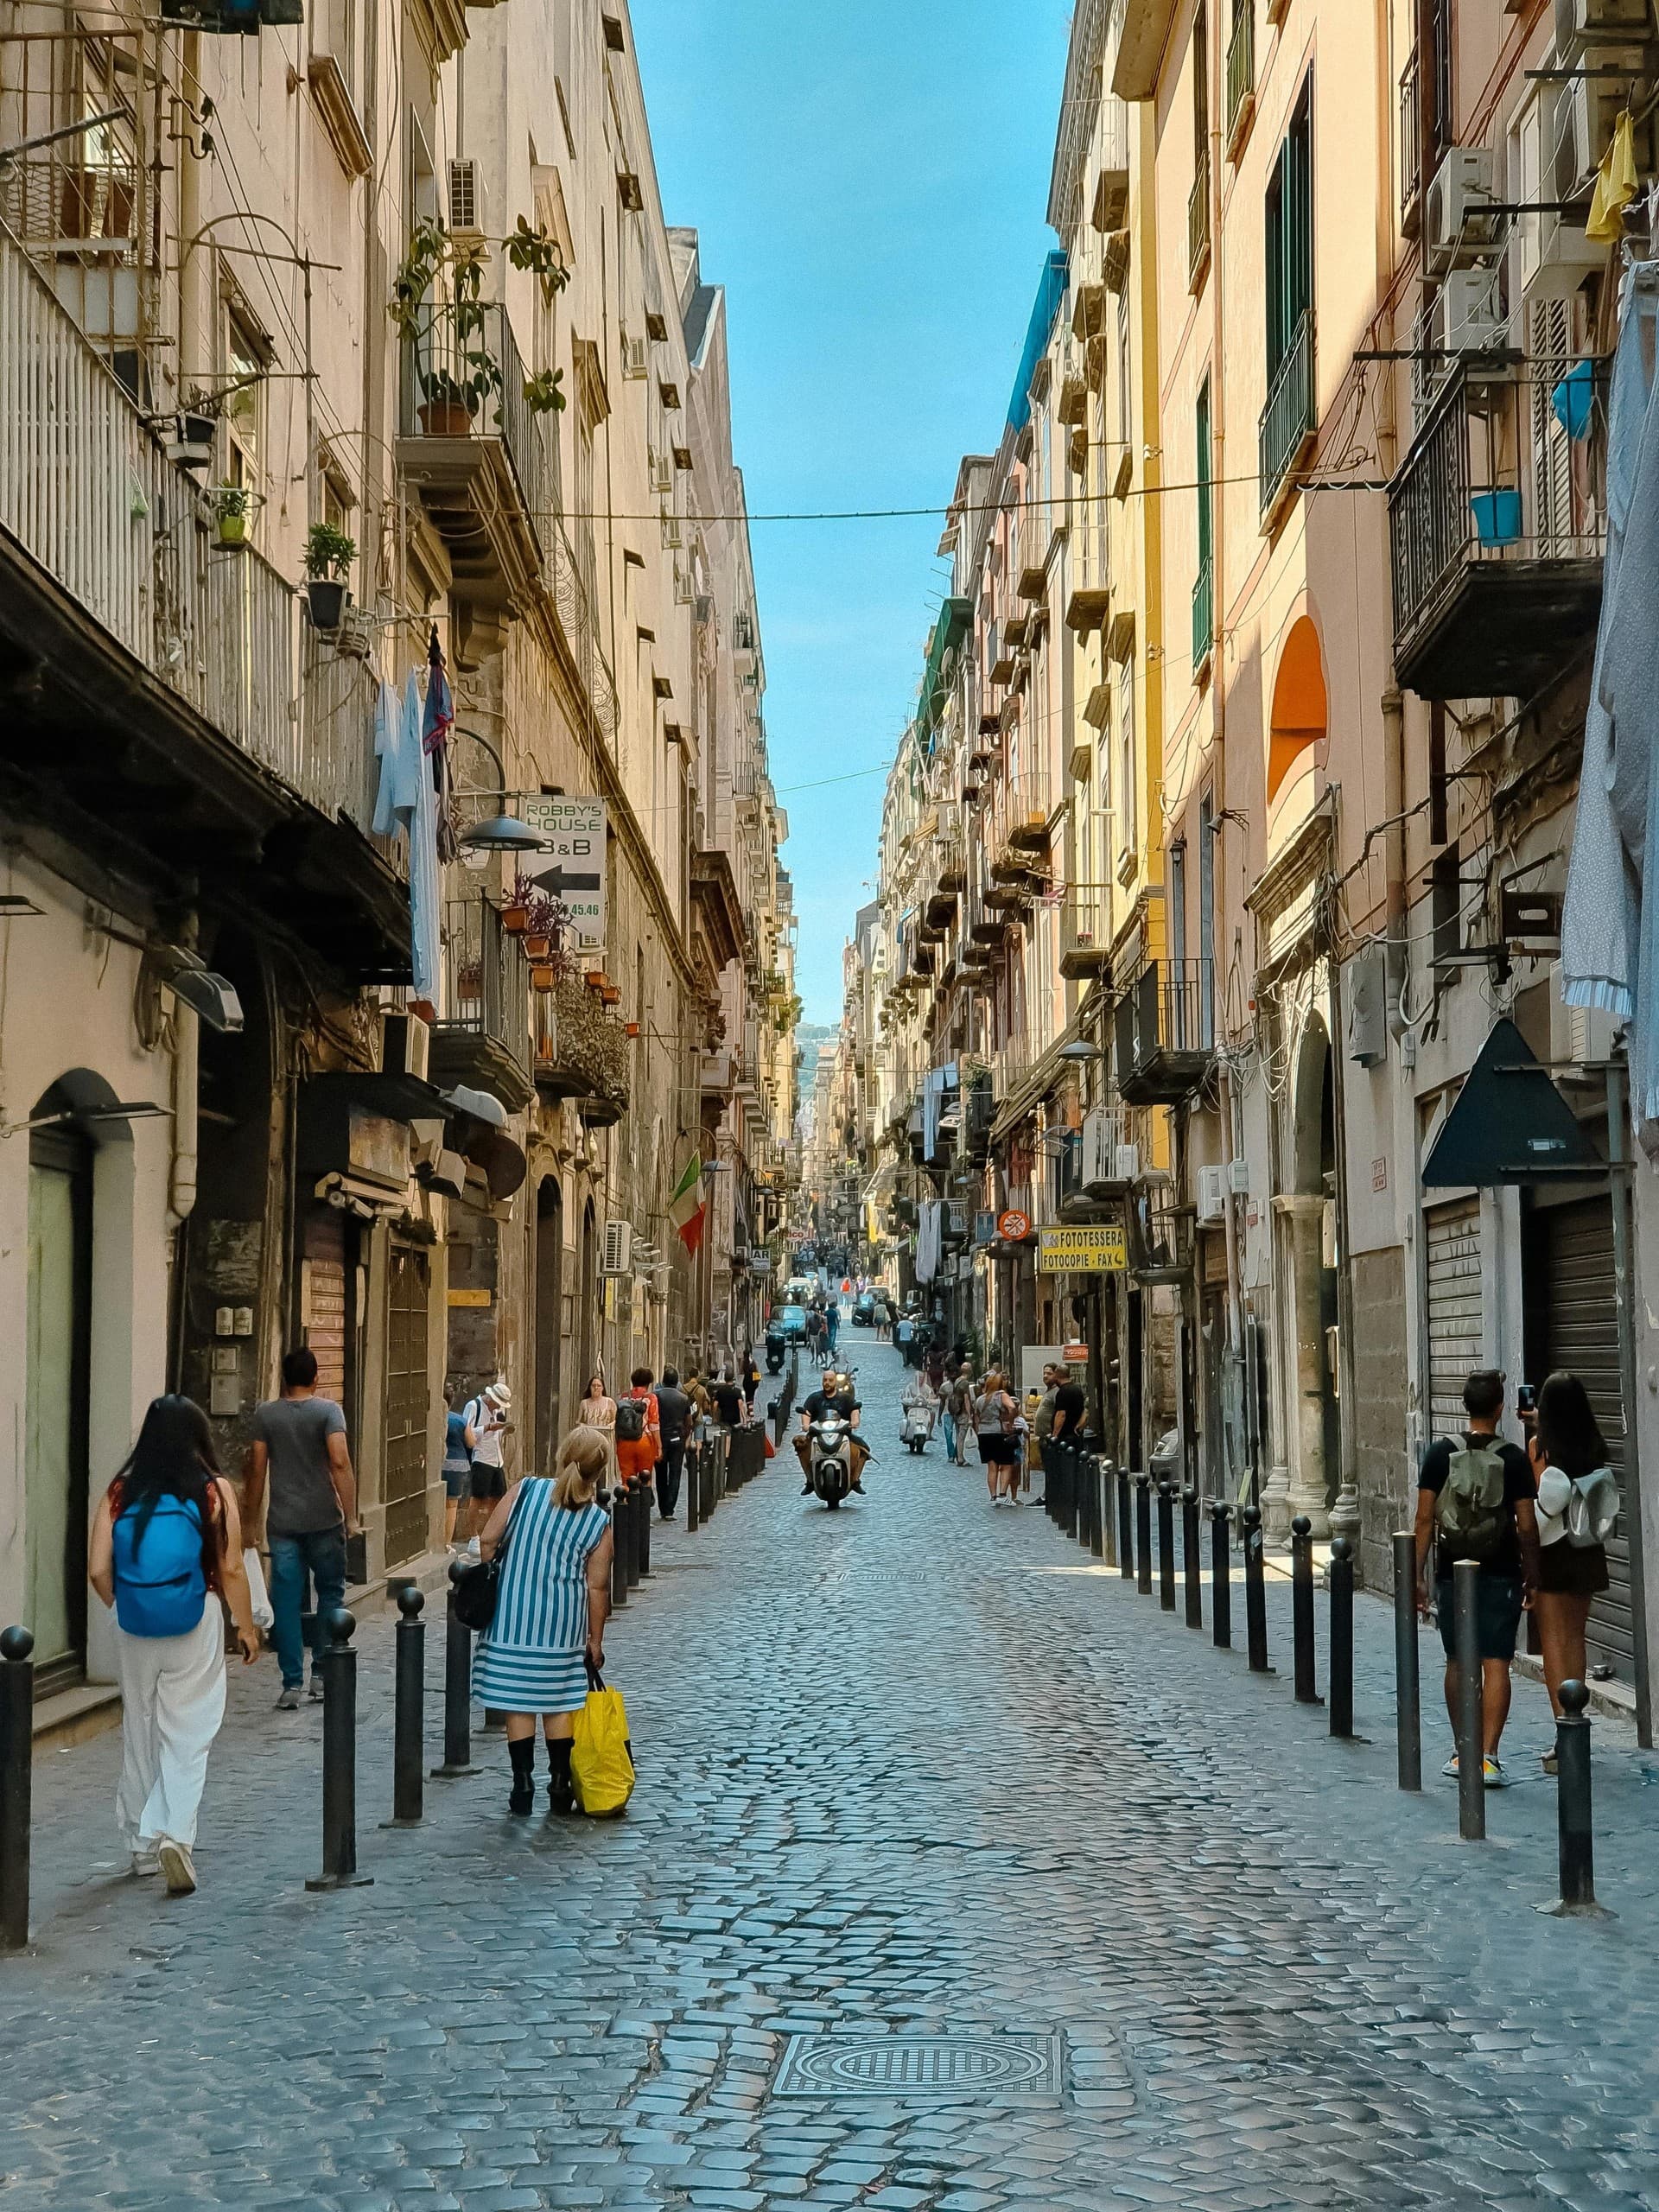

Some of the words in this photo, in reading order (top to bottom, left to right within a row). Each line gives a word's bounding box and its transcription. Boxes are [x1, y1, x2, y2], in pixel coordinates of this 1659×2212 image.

[526, 804, 601, 817] ROBBY'S
[527, 817, 601, 831] HOUSE
[536, 838, 591, 855] B&B
[1060, 1230, 1123, 1248] FOTOTESSERA
[1044, 1254, 1090, 1268] FOTOCOPIE
[1097, 1253, 1113, 1267] FAX
